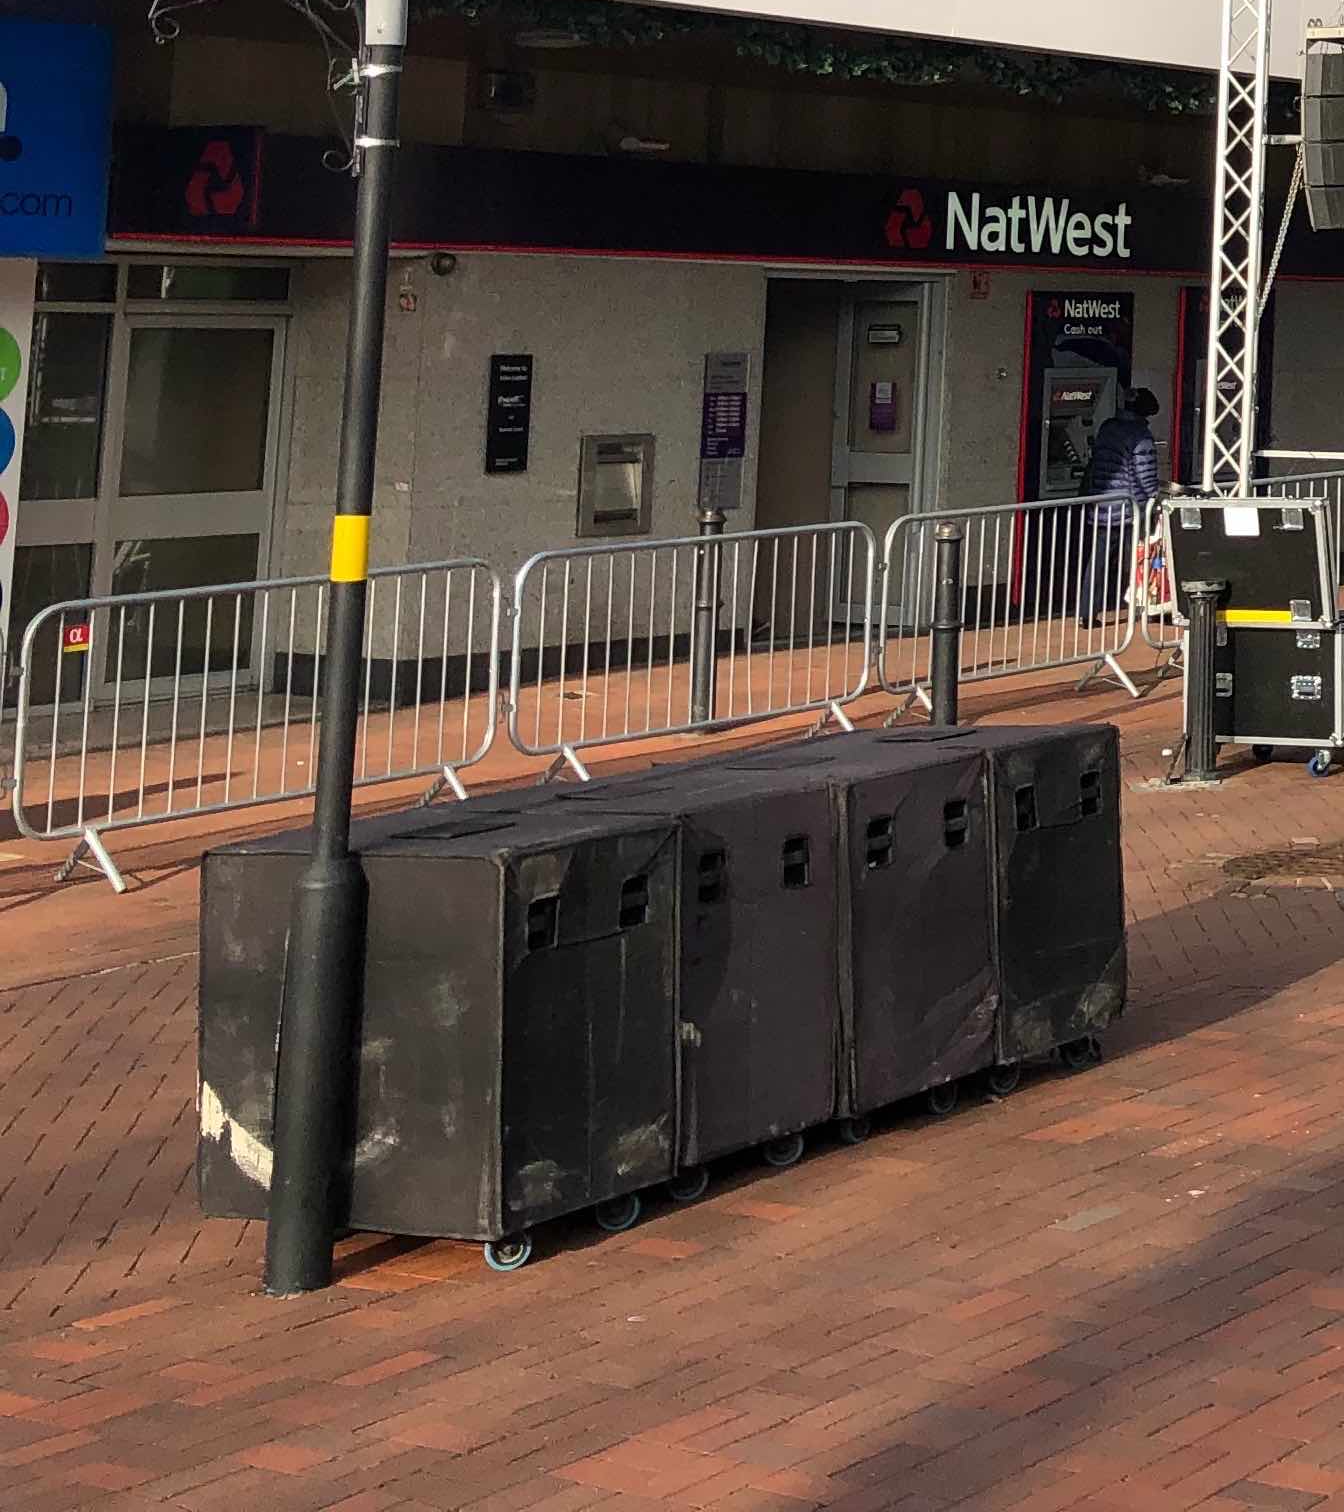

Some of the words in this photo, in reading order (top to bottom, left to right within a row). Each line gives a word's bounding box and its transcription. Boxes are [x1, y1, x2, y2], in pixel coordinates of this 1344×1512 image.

[945, 191, 1132, 258] NatWest
[1064, 298, 1121, 318] NatWest
[1063, 323, 1086, 335] Cash
[1087, 324, 1103, 335] out
